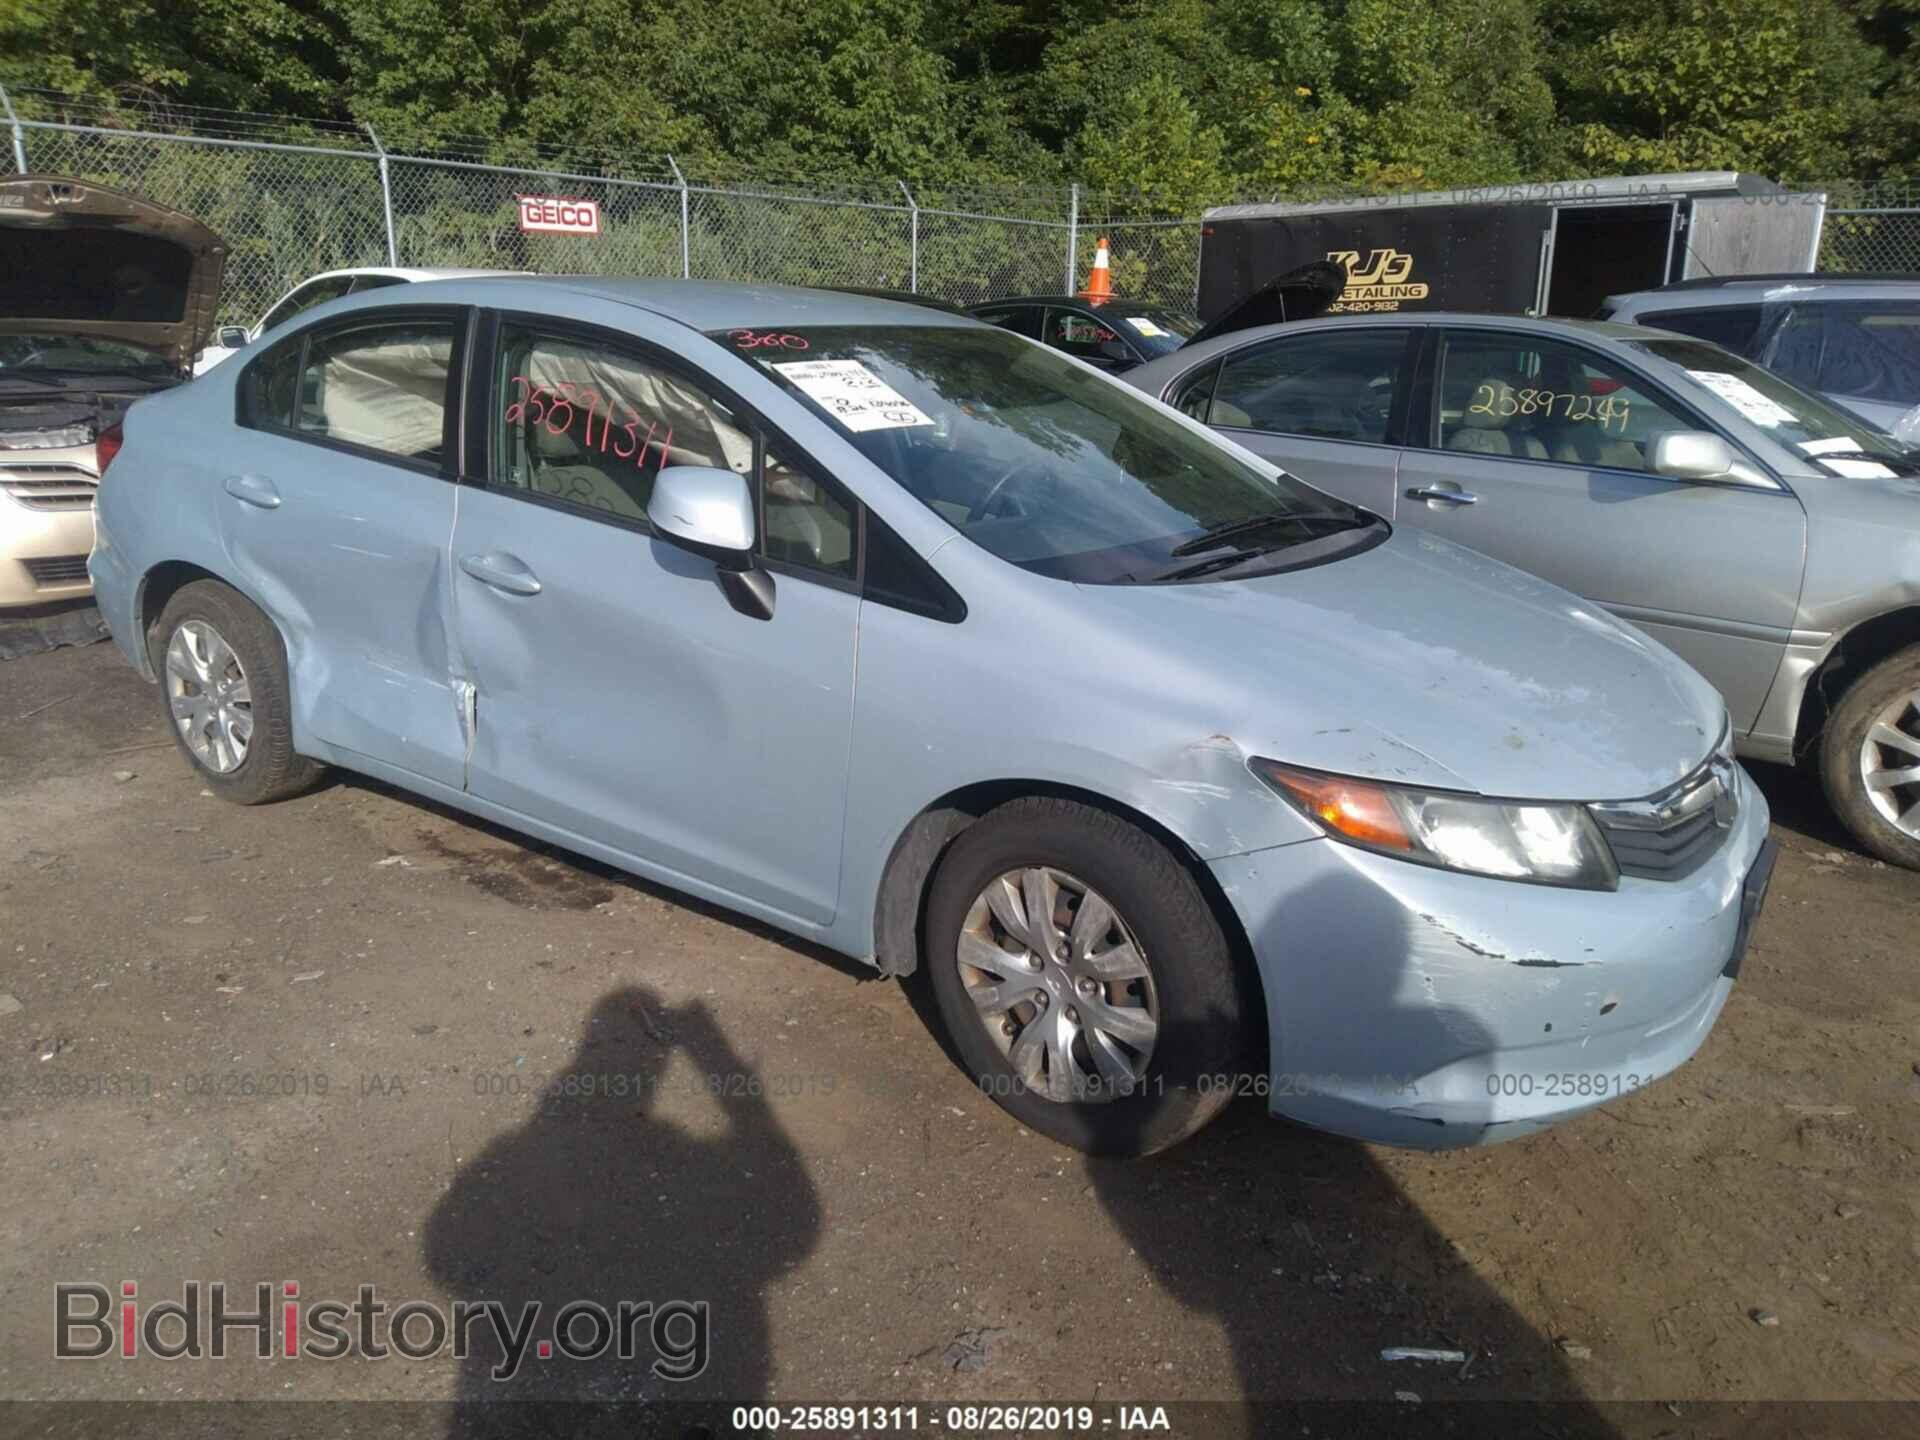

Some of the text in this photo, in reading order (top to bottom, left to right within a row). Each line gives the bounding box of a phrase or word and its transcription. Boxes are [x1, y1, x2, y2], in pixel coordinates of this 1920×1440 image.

[526, 203, 593, 226] GEICO
[1341, 286, 1422, 299] ETAILING
[1328, 302, 1399, 312] 02-420-9132
[727, 328, 809, 350] 360
[1469, 384, 1630, 433] 25897249
